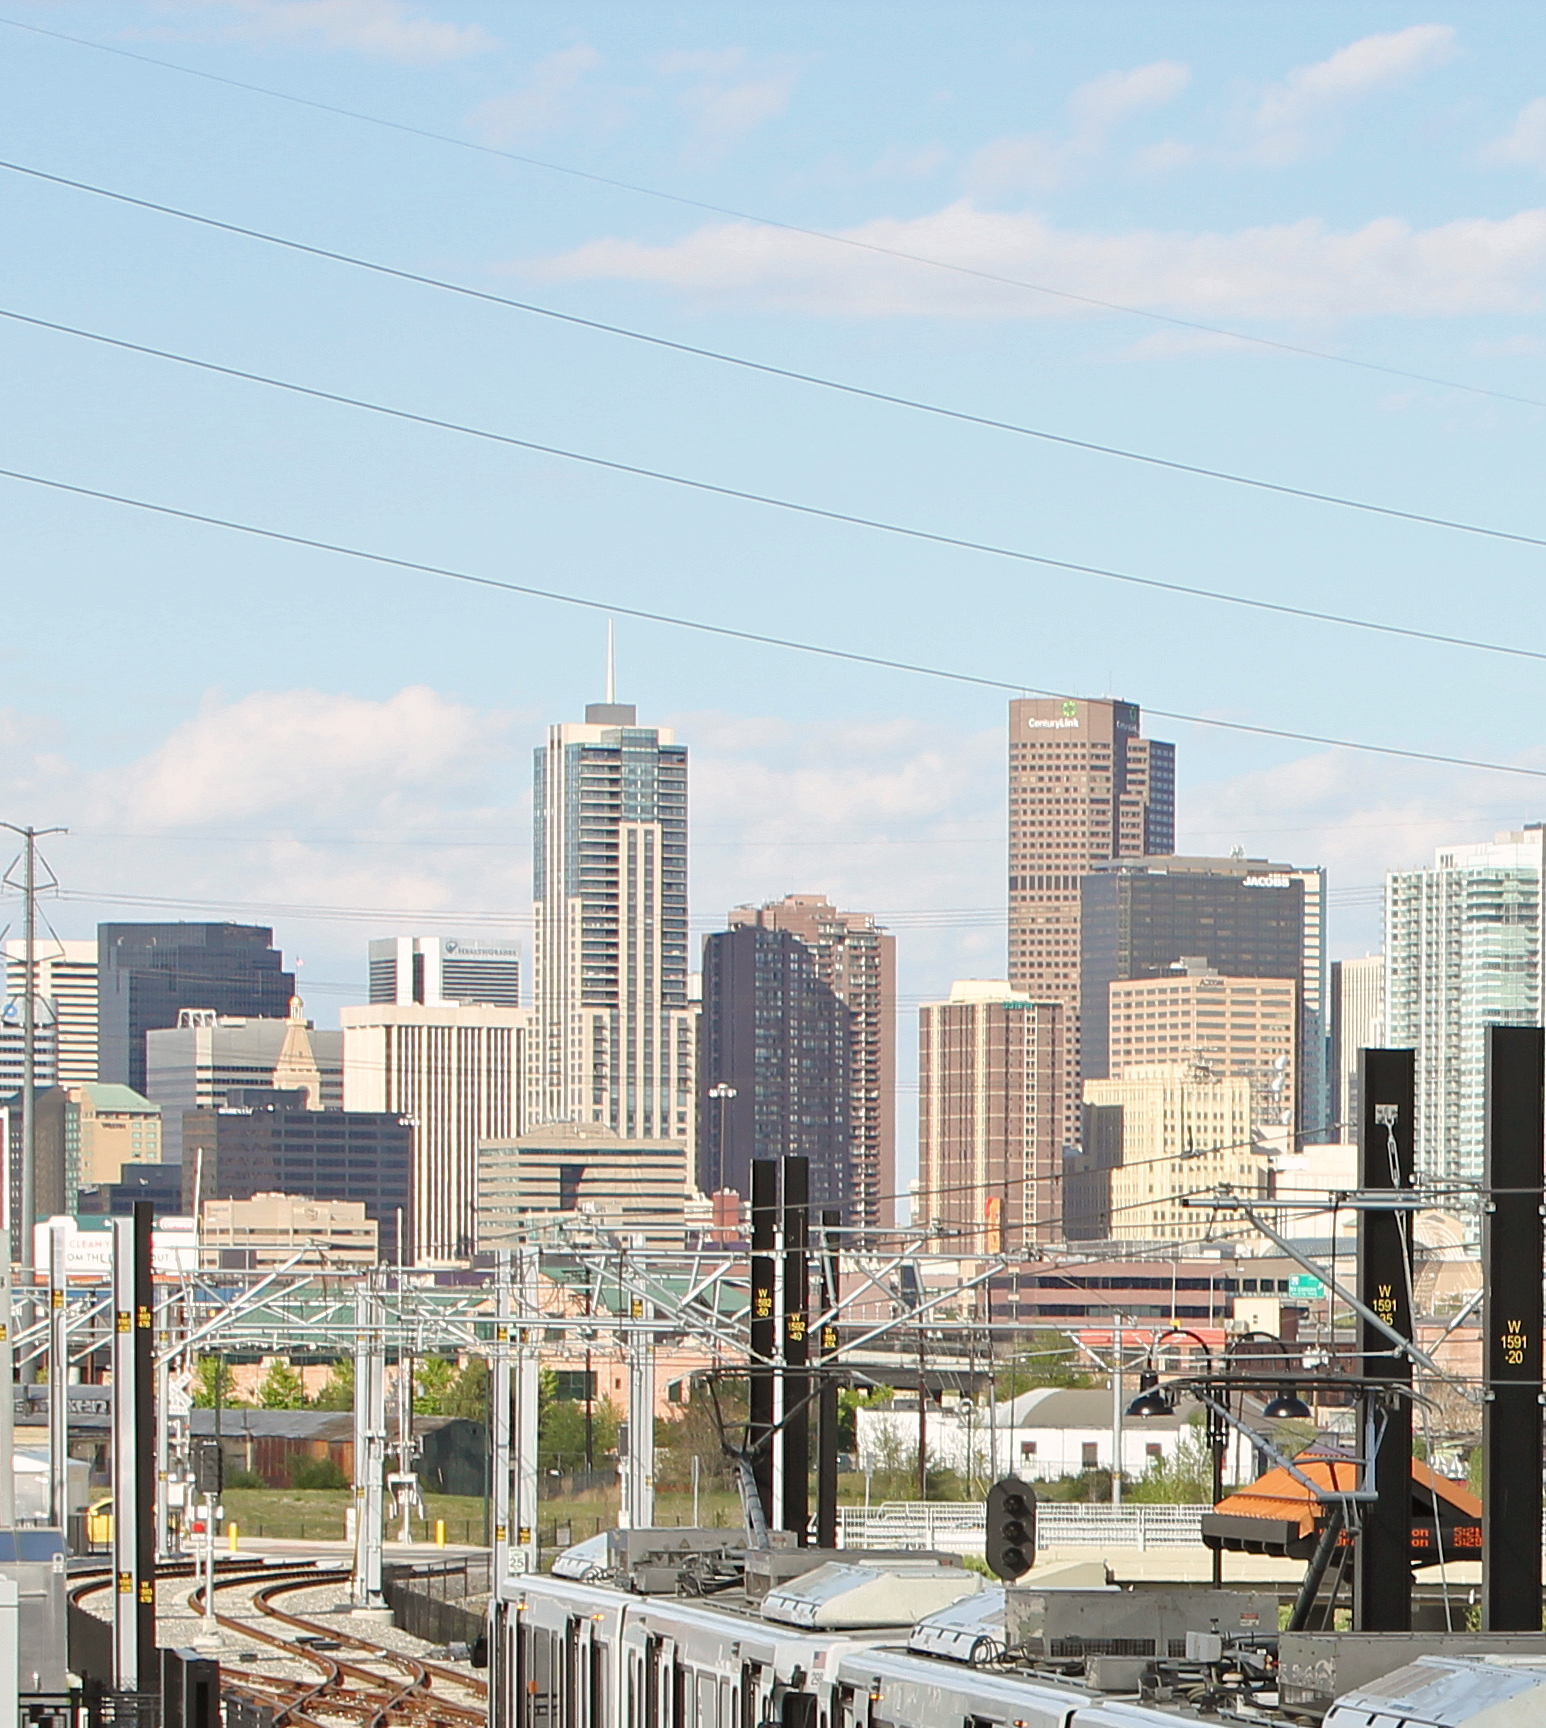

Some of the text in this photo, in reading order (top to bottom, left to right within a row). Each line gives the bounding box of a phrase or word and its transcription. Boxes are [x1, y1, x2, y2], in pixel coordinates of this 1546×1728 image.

[1028, 717, 1079, 729] CenturyLink
[1242, 875, 1290, 888] JACOBS
[758, 1288, 769, 1298] W
[1378, 1284, 1392, 1298] W
[1372, 1299, 1397, 1312] 1591
[1507, 1320, 1521, 1334] W
[1500, 1334, 1527, 1349] 1591
[1453, 1526, 1482, 1538] 5:21
